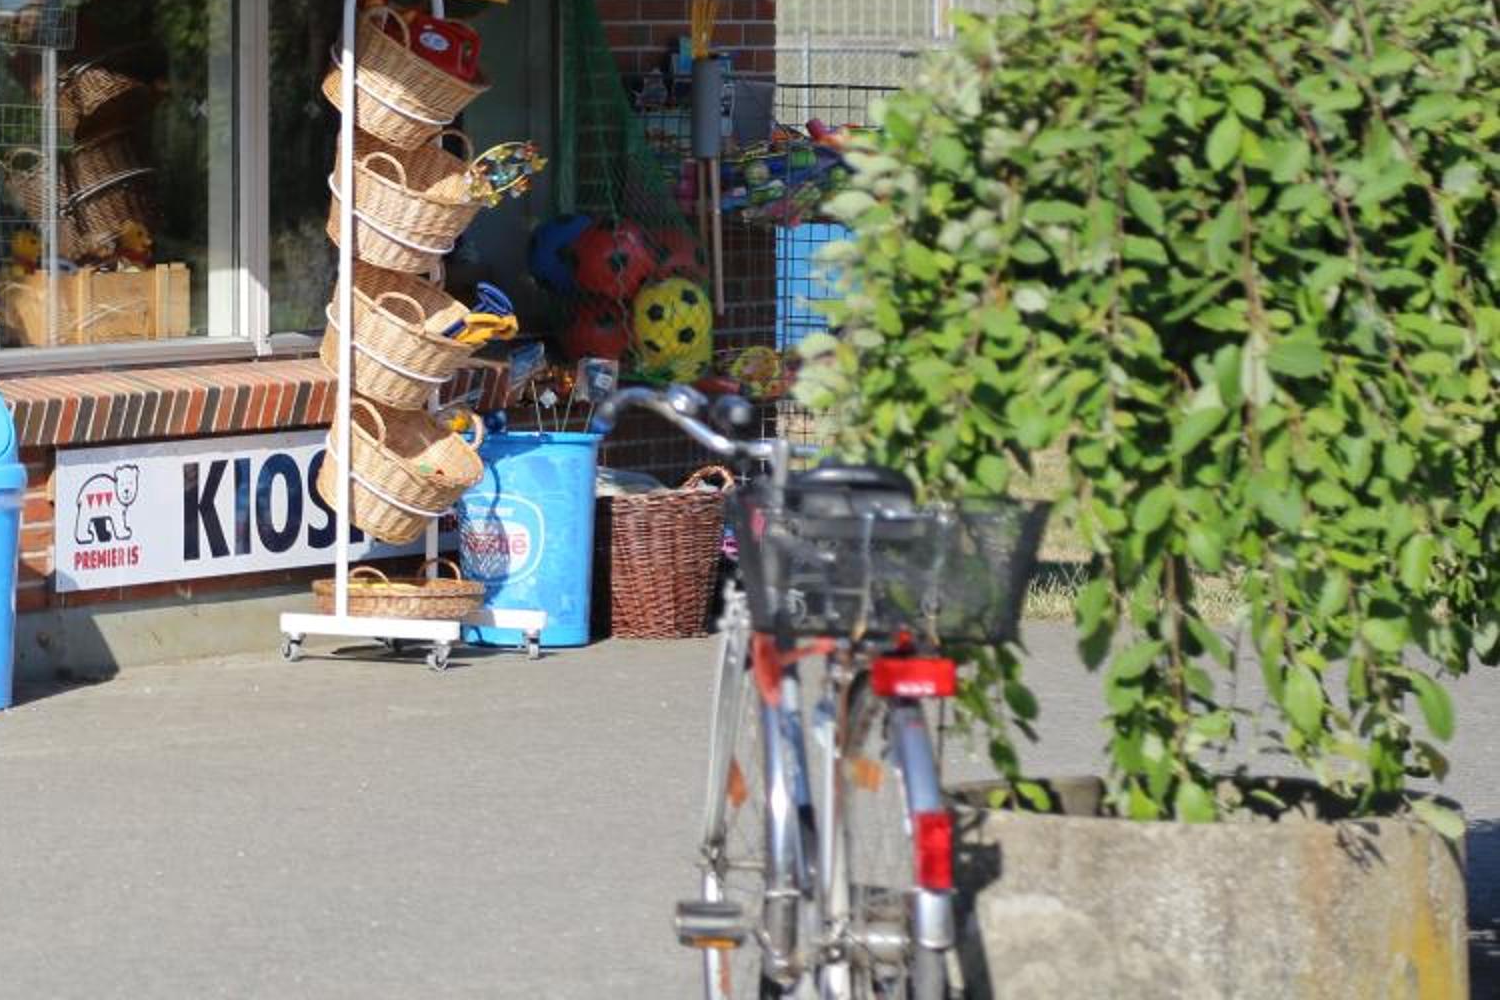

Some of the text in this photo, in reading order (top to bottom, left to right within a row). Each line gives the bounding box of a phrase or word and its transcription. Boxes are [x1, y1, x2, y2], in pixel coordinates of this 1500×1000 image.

[183, 453, 364, 562] KIOS
[74, 545, 139, 571] PREMIER IS
